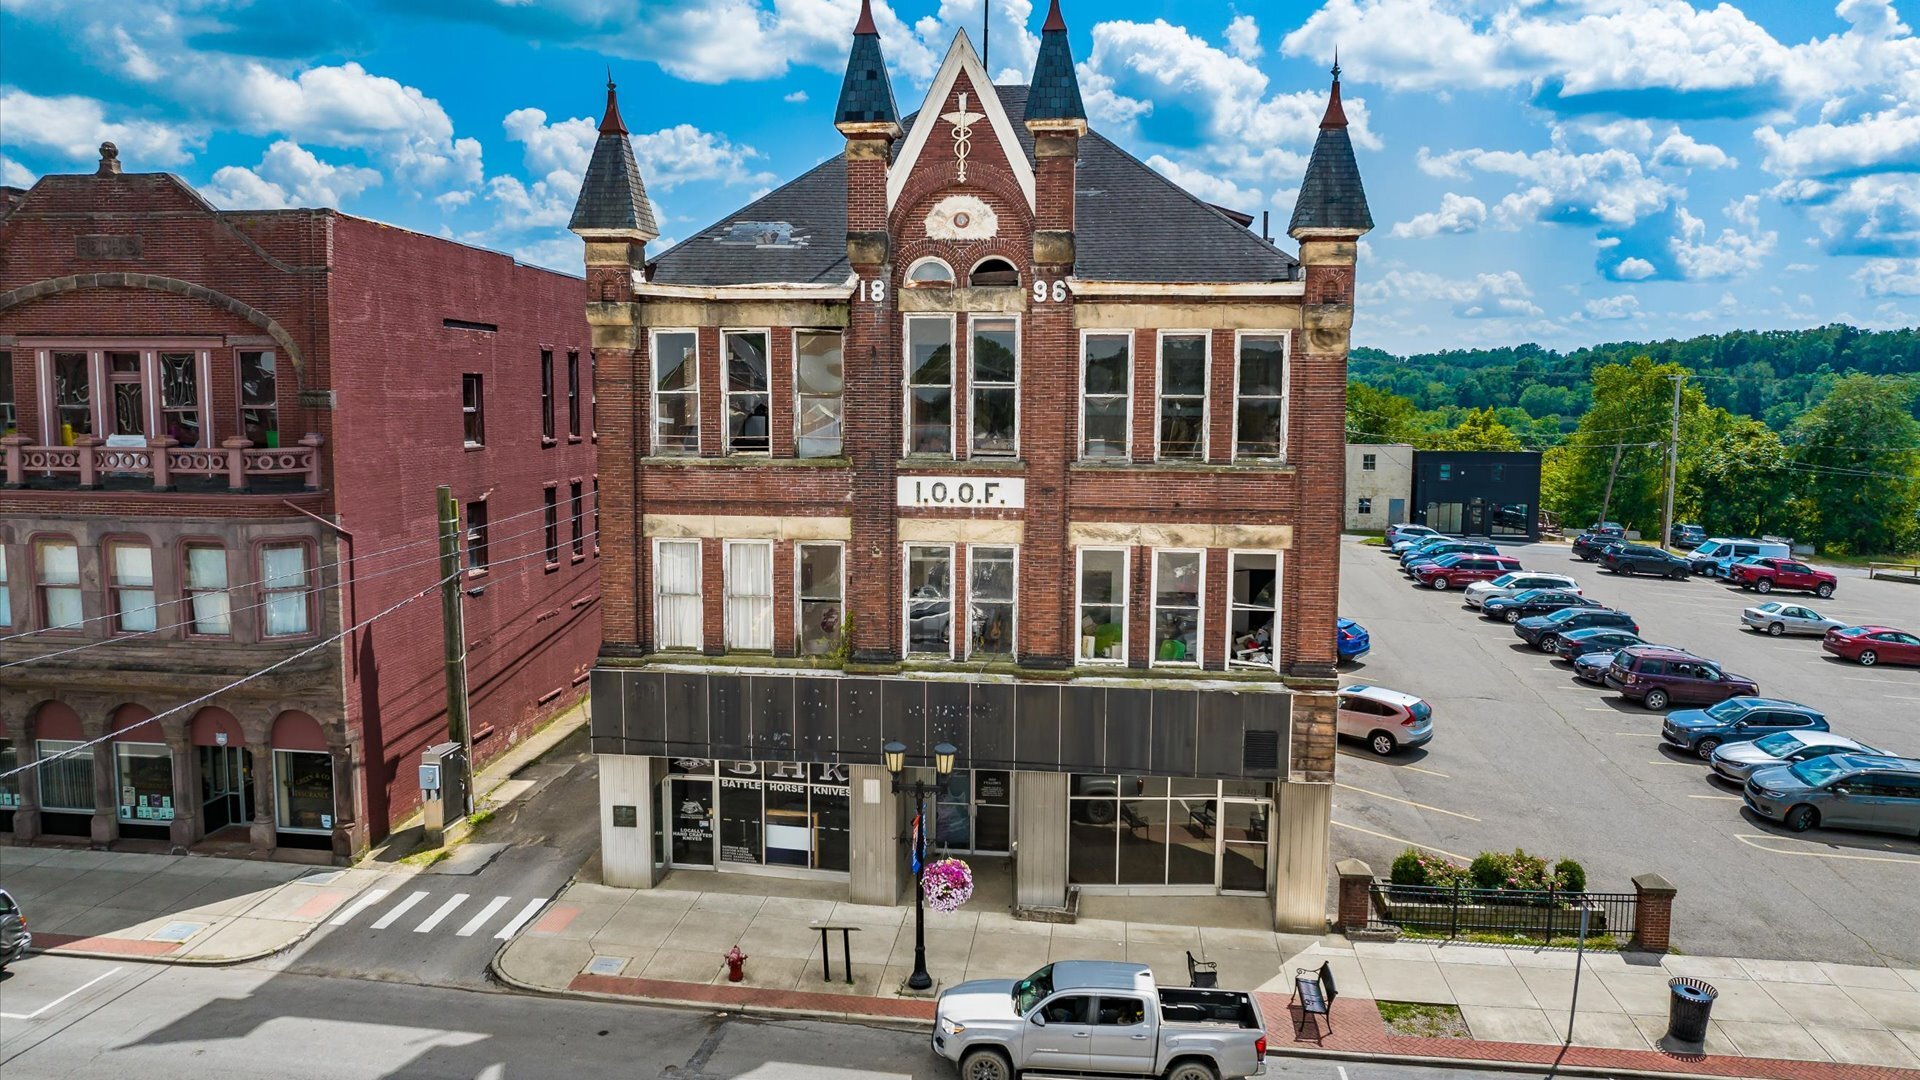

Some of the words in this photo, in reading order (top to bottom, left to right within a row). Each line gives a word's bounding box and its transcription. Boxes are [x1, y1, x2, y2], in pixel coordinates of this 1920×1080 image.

[860, 279, 885, 302] 18
[1033, 280, 1067, 303] 96
[916, 481, 1006, 504] I.O.O.F.
[721, 779, 762, 790] BATTLE
[769, 783, 805, 793] HORSE
[813, 786, 850, 797] KNIVES
